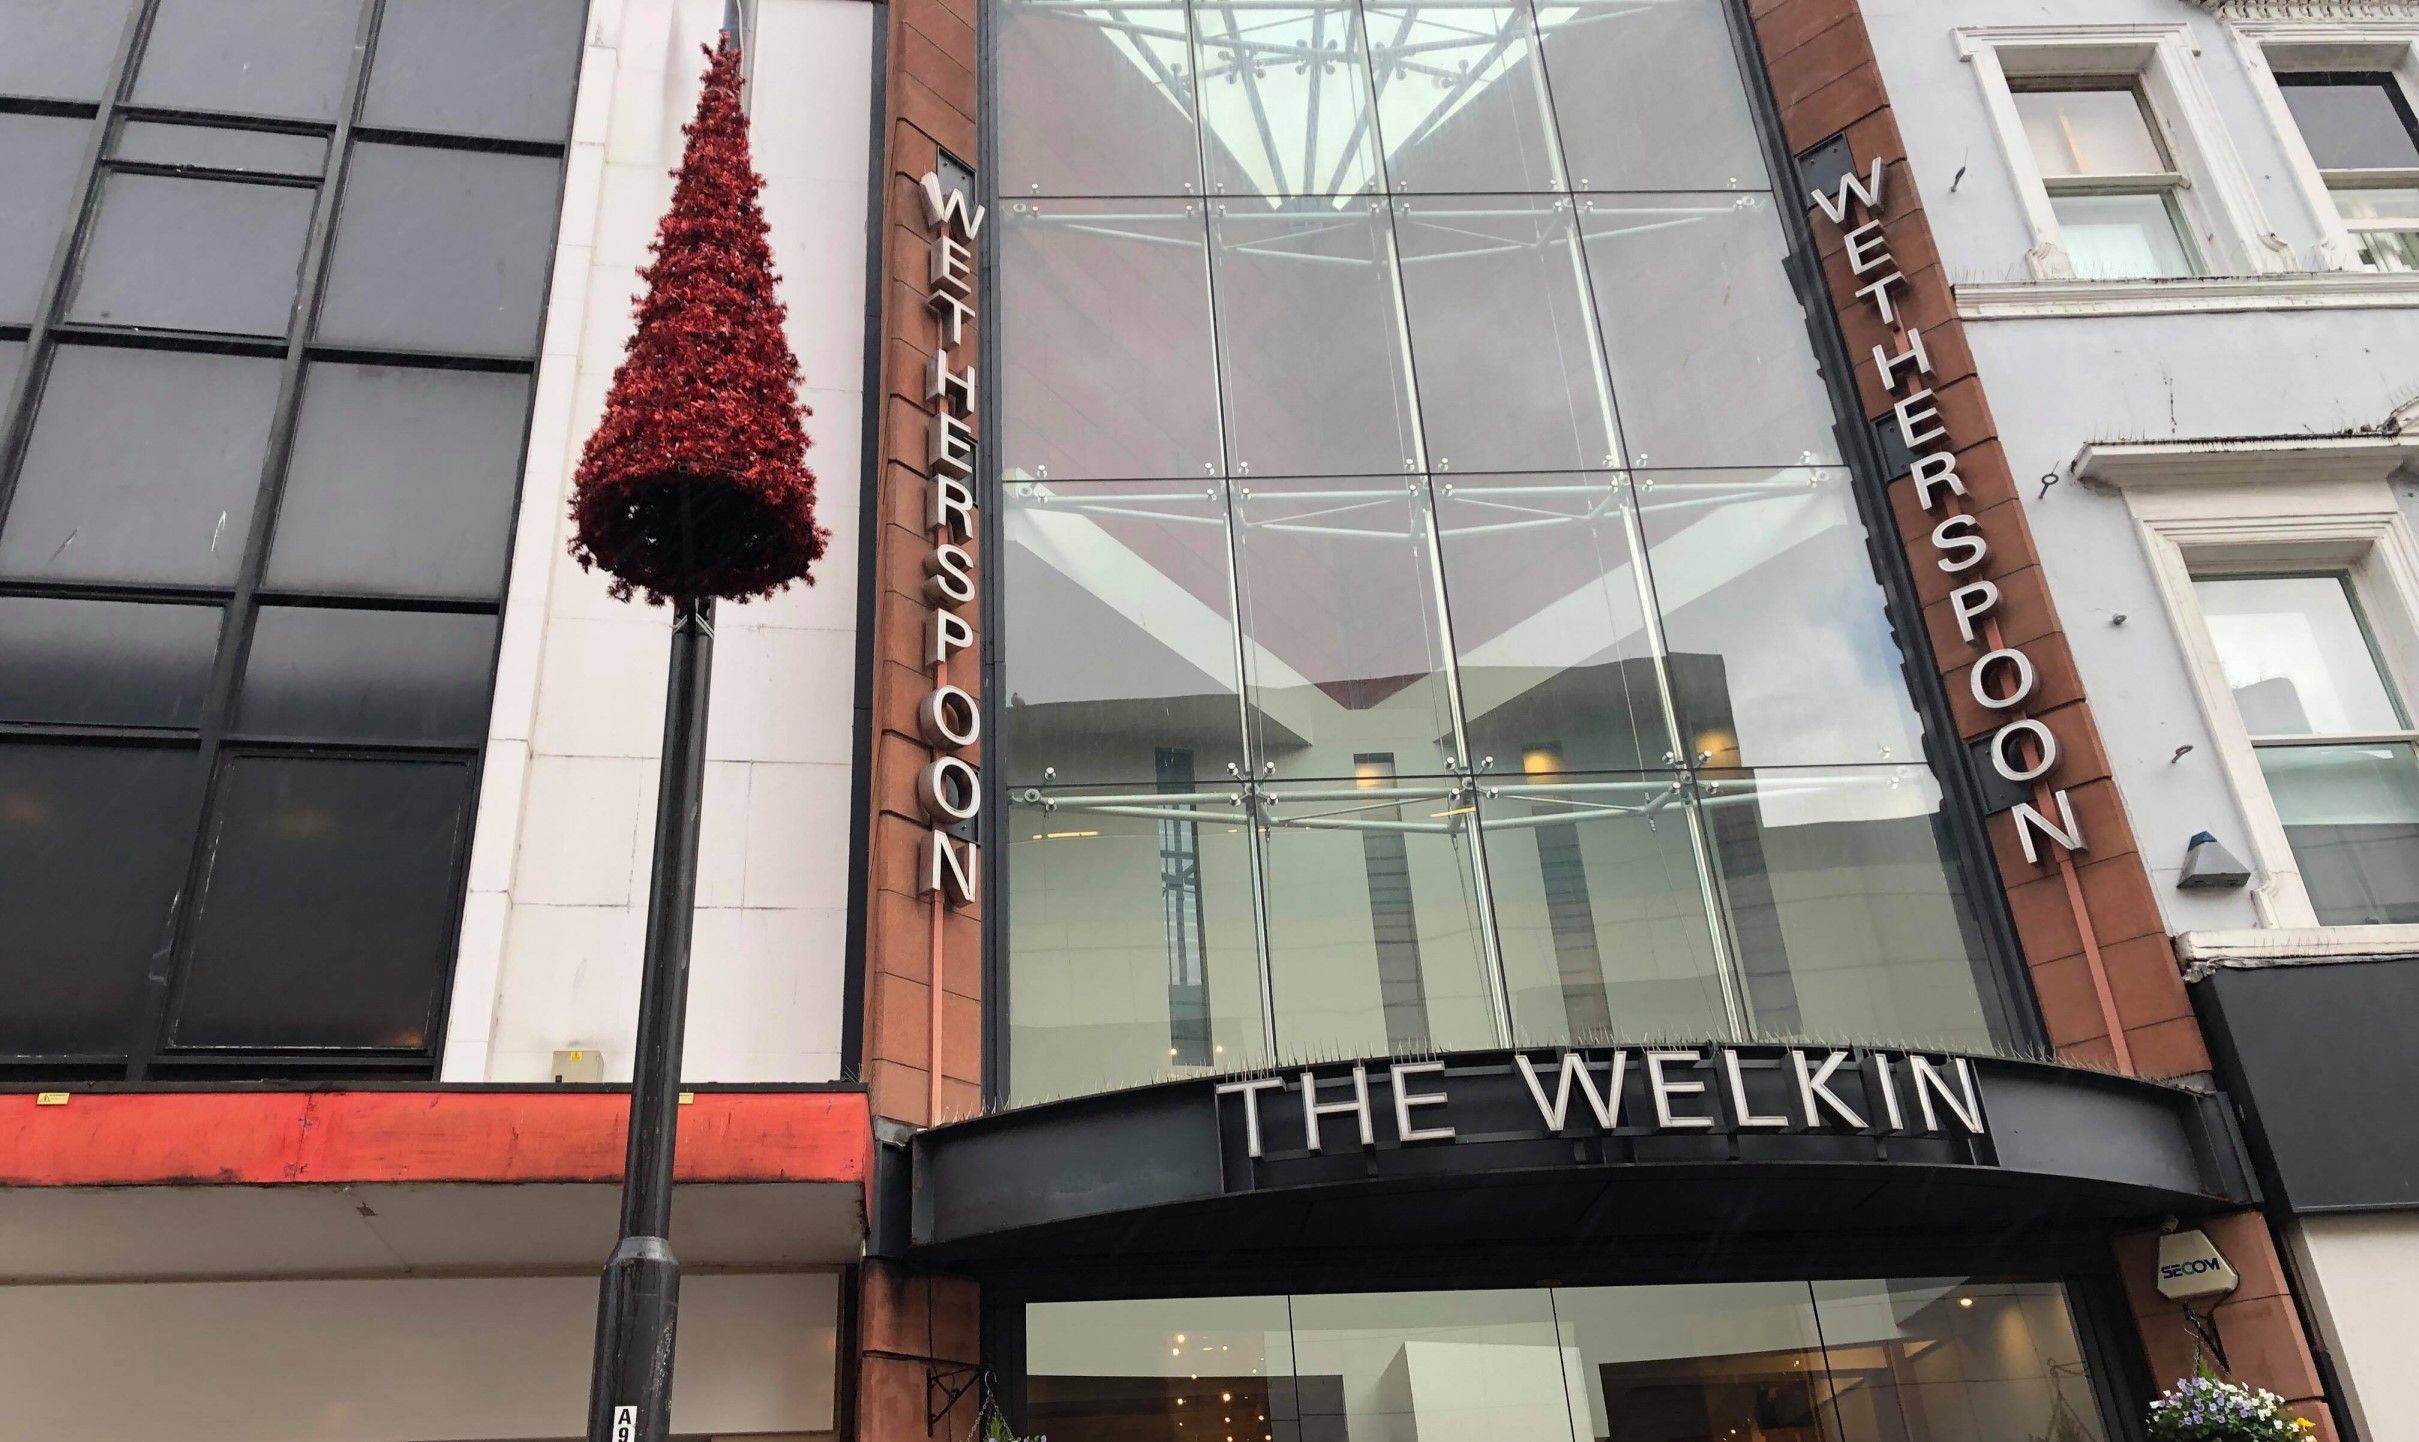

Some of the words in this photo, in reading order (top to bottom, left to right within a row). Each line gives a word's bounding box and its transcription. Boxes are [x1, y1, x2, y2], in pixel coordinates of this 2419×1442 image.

[921, 171, 986, 903] WETHERSPOON
[1810, 156, 2085, 864] WETHERSPOON
[1215, 1060, 1457, 1158] THE
[1514, 1049, 1985, 1134] WELKIN
[2161, 1257, 2221, 1279] SECOM
